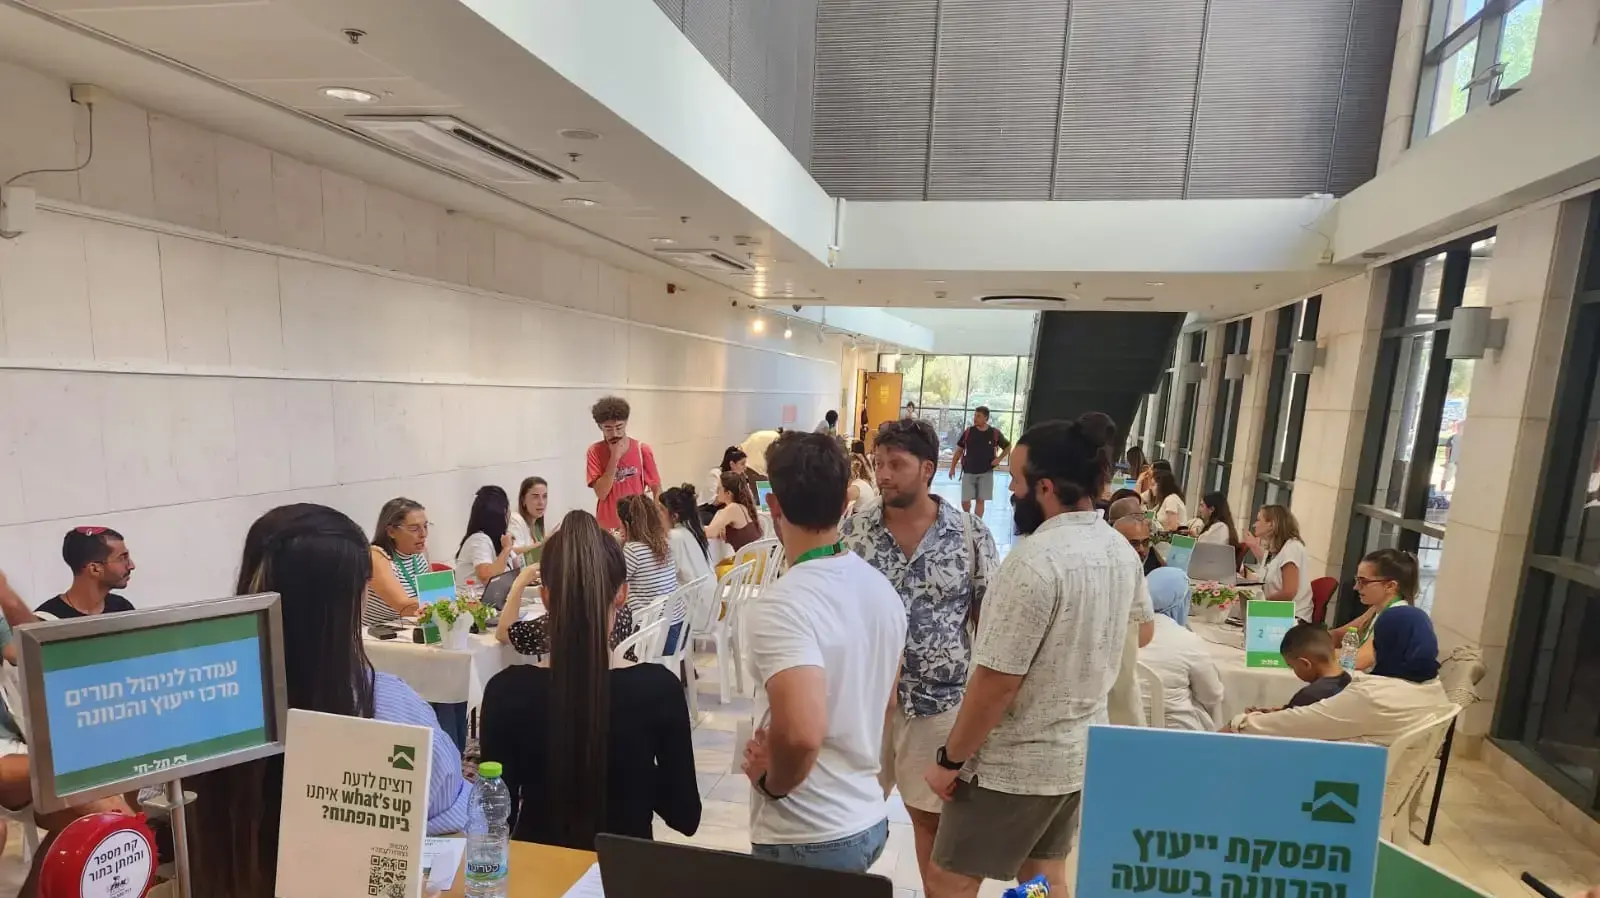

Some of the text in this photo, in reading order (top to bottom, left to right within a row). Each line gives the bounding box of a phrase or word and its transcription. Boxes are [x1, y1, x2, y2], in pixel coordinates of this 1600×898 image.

[64, 660, 238, 708] עמדה לניהול תורים
[76, 681, 240, 728] מרכז ייעוץ והכוונה
[342, 771, 413, 795] רוצים לדעת
[306, 784, 412, 816] what's up איתנו
[321, 805, 410, 832] ביום הפתוח?
[89, 850, 144, 882] והמתן בתור
[94, 839, 138, 865] קח מספר
[1131, 828, 1351, 873] הפסקת ייעוץ
[1111, 863, 1212, 897] בשעה
